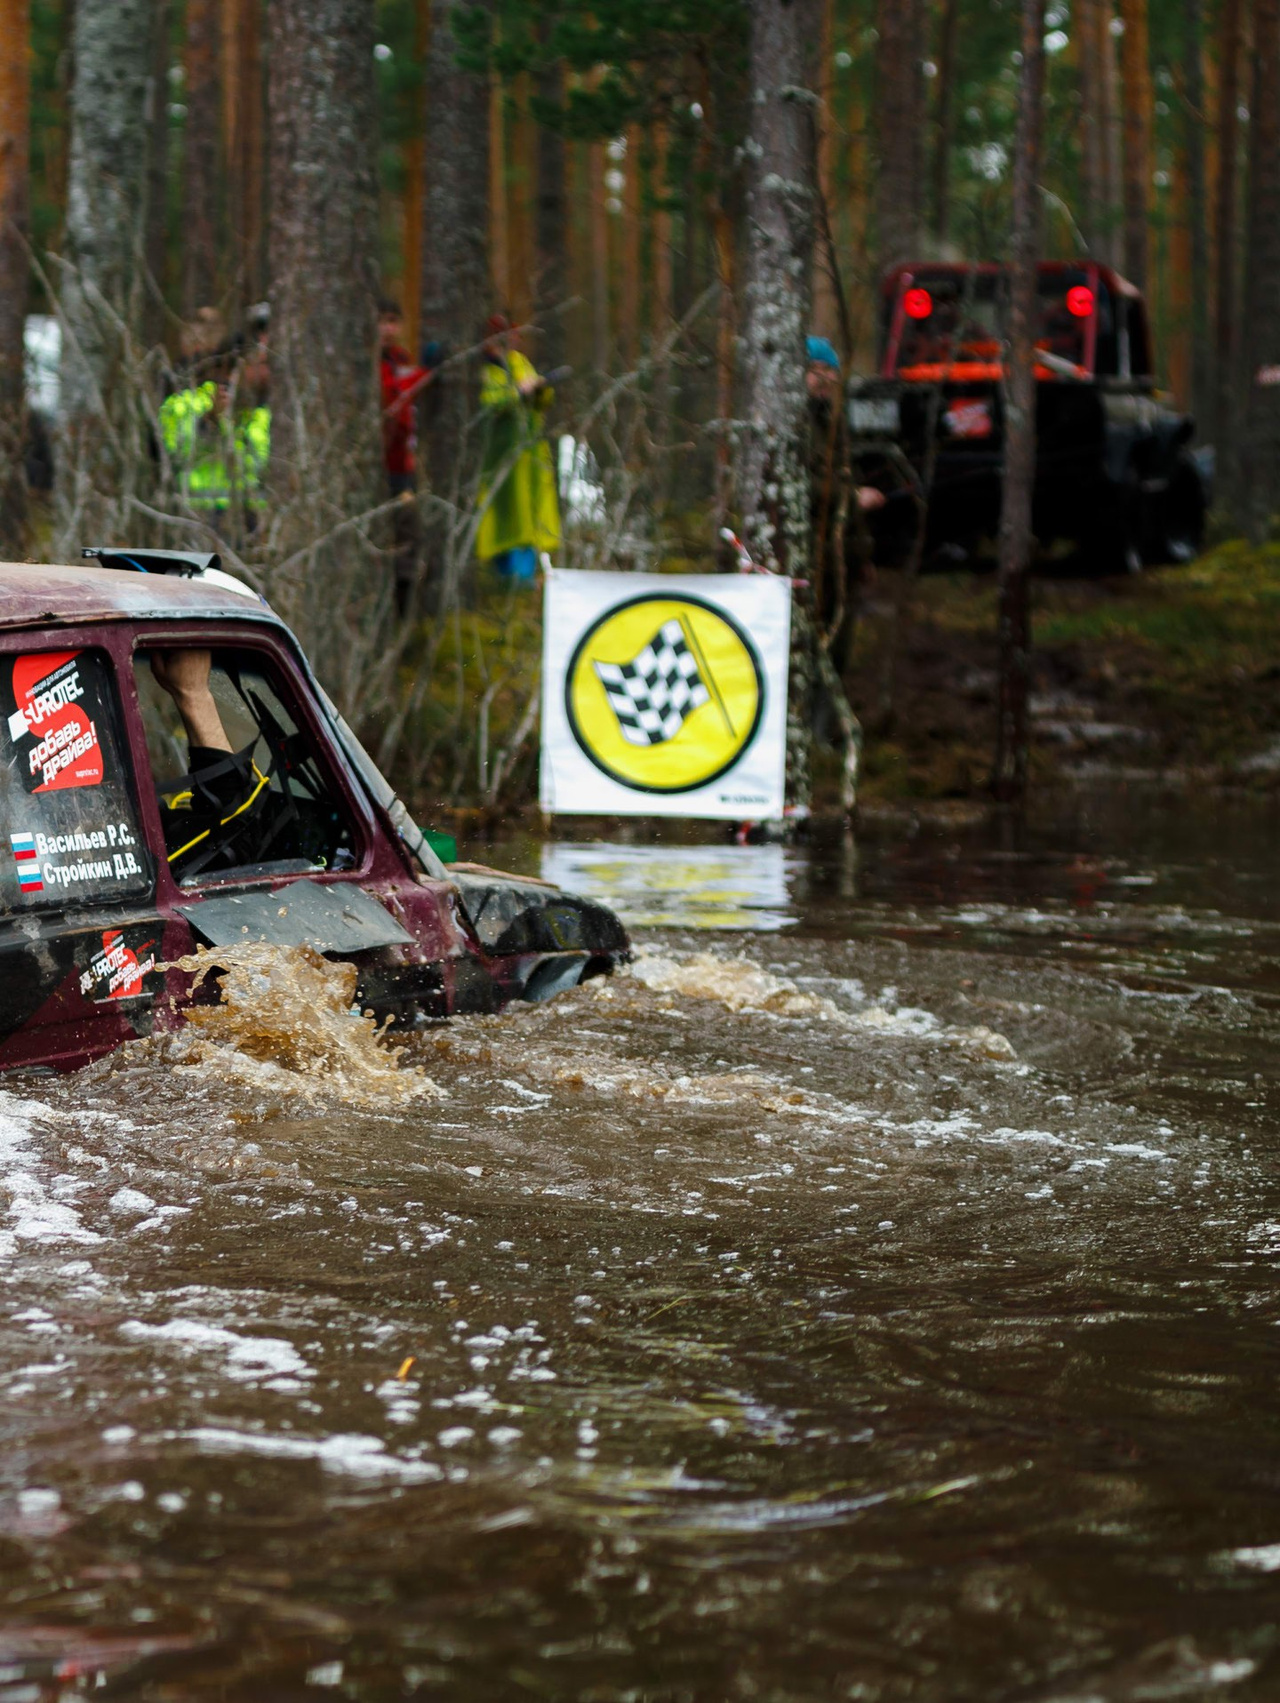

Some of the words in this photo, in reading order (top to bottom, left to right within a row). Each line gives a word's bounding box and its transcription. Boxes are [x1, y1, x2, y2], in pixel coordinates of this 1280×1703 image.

[35, 831, 108, 855] Васильев
[107, 823, 136, 847] Р.С.
[43, 858, 113, 887] Стройкин
[112, 852, 142, 880] Д.В.
